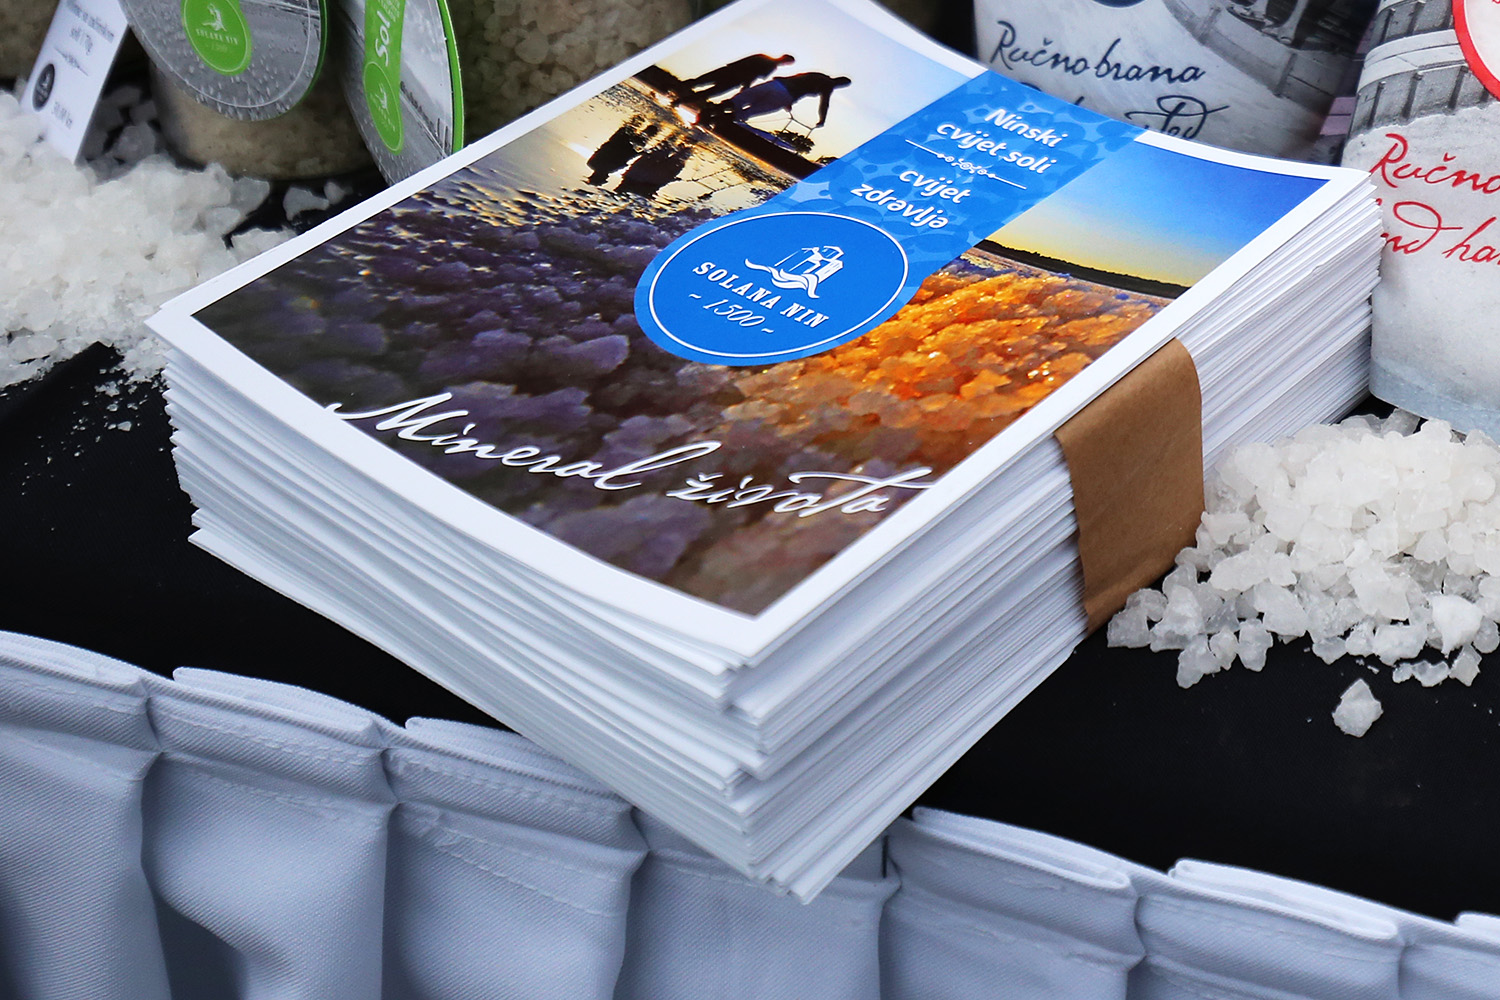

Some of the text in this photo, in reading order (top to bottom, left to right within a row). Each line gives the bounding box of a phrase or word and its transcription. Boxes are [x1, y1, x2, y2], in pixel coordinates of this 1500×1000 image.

[376, 10, 391, 67] Sol
[990, 20, 1090, 75] Ručno
[936, 123, 1057, 174] cvijet soli
[985, 109, 1068, 148] Ninski
[850, 184, 949, 228] zdravlja
[899, 170, 971, 203] cvijet
[693, 261, 829, 328] SOLANA NIN
[325, 392, 721, 490] Mineral
